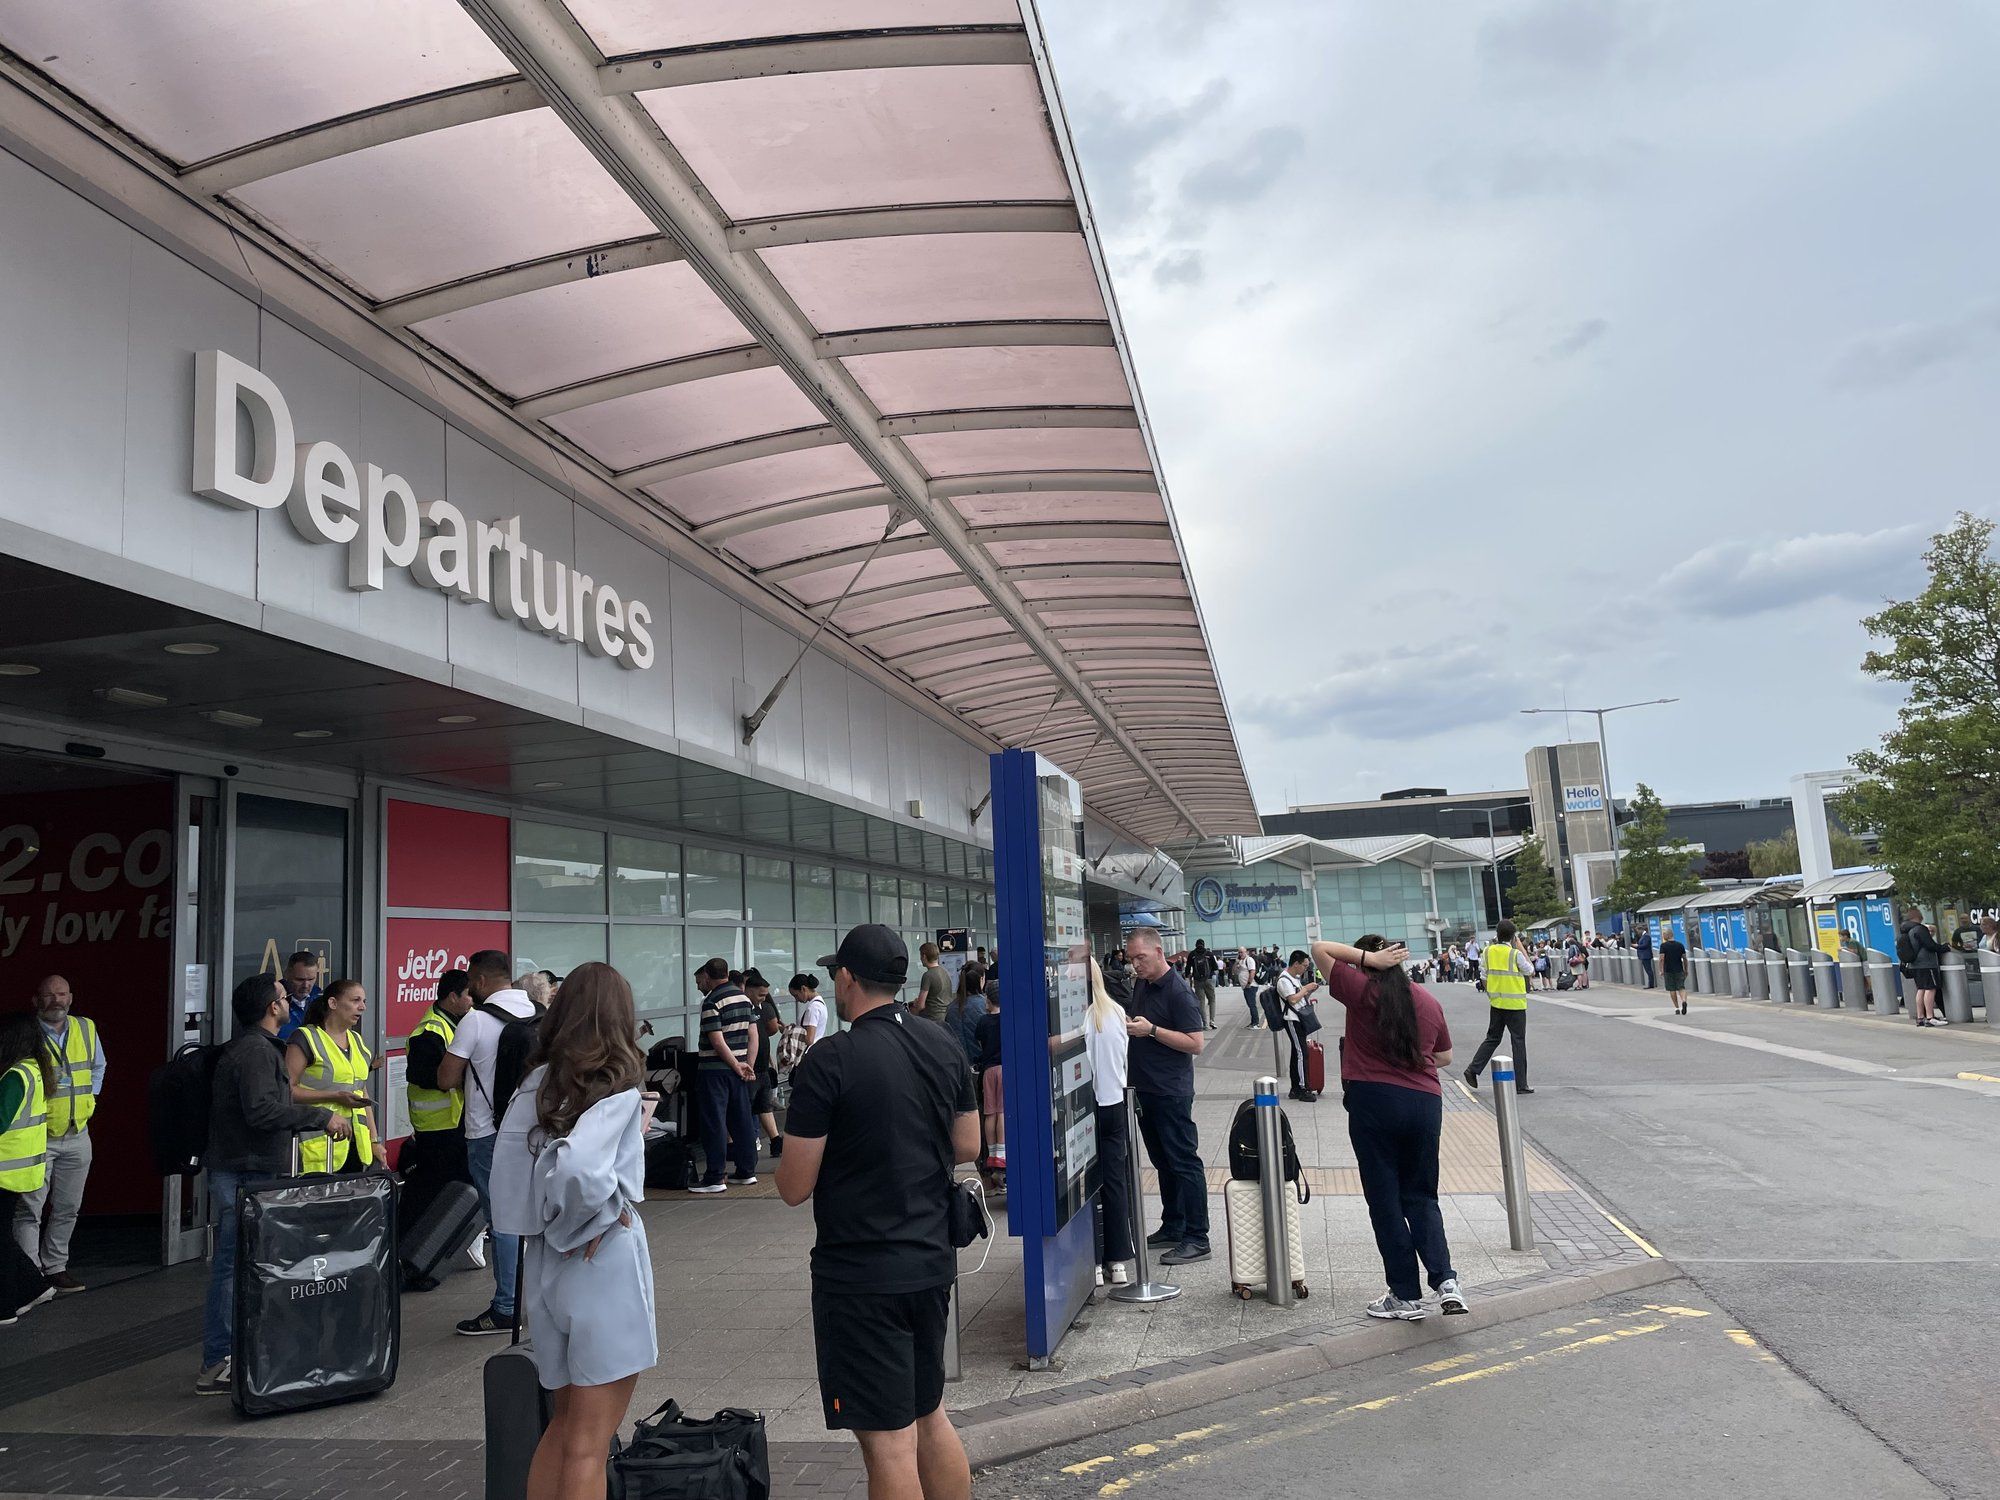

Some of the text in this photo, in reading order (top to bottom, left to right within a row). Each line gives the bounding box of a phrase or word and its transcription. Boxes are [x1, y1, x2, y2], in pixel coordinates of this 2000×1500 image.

[192, 350, 654, 670] Departures
[1566, 787, 1599, 798] Hello
[1567, 798, 1601, 810] world
[1228, 897, 1269, 916] Airport
[1883, 906, 1890, 921] B
[41, 902, 125, 945] low
[1720, 923, 1728, 948] C
[290, 1277, 348, 1300] PIGEON
